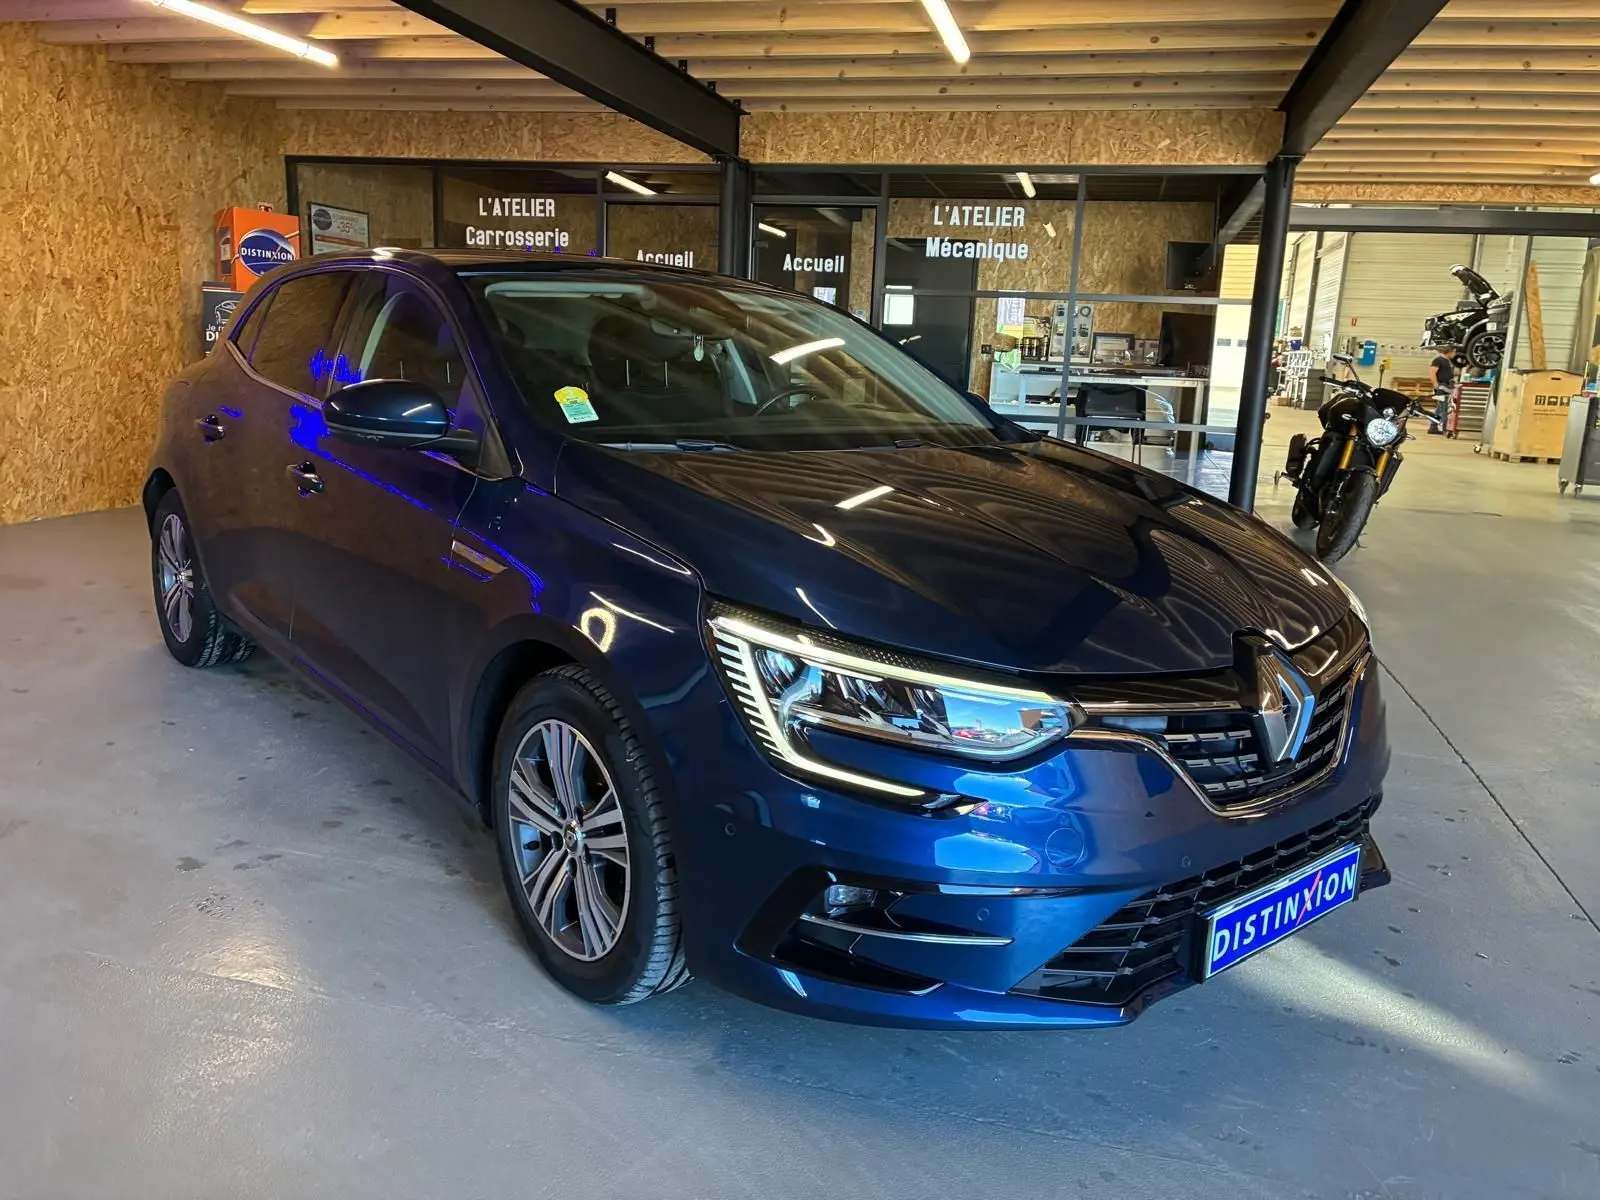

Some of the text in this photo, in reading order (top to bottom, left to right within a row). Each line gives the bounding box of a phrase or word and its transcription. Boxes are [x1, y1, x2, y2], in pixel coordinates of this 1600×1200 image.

[479, 198, 556, 217] L'ATELIER
[933, 205, 1025, 227] L'ATELIER
[466, 226, 569, 247] Carrosserie
[241, 246, 293, 261] DISTINXION
[636, 249, 694, 269] Accueil
[925, 236, 1029, 262] Mécanique
[783, 253, 845, 273] Accueil
[1213, 864, 1356, 962] DISTINXION
